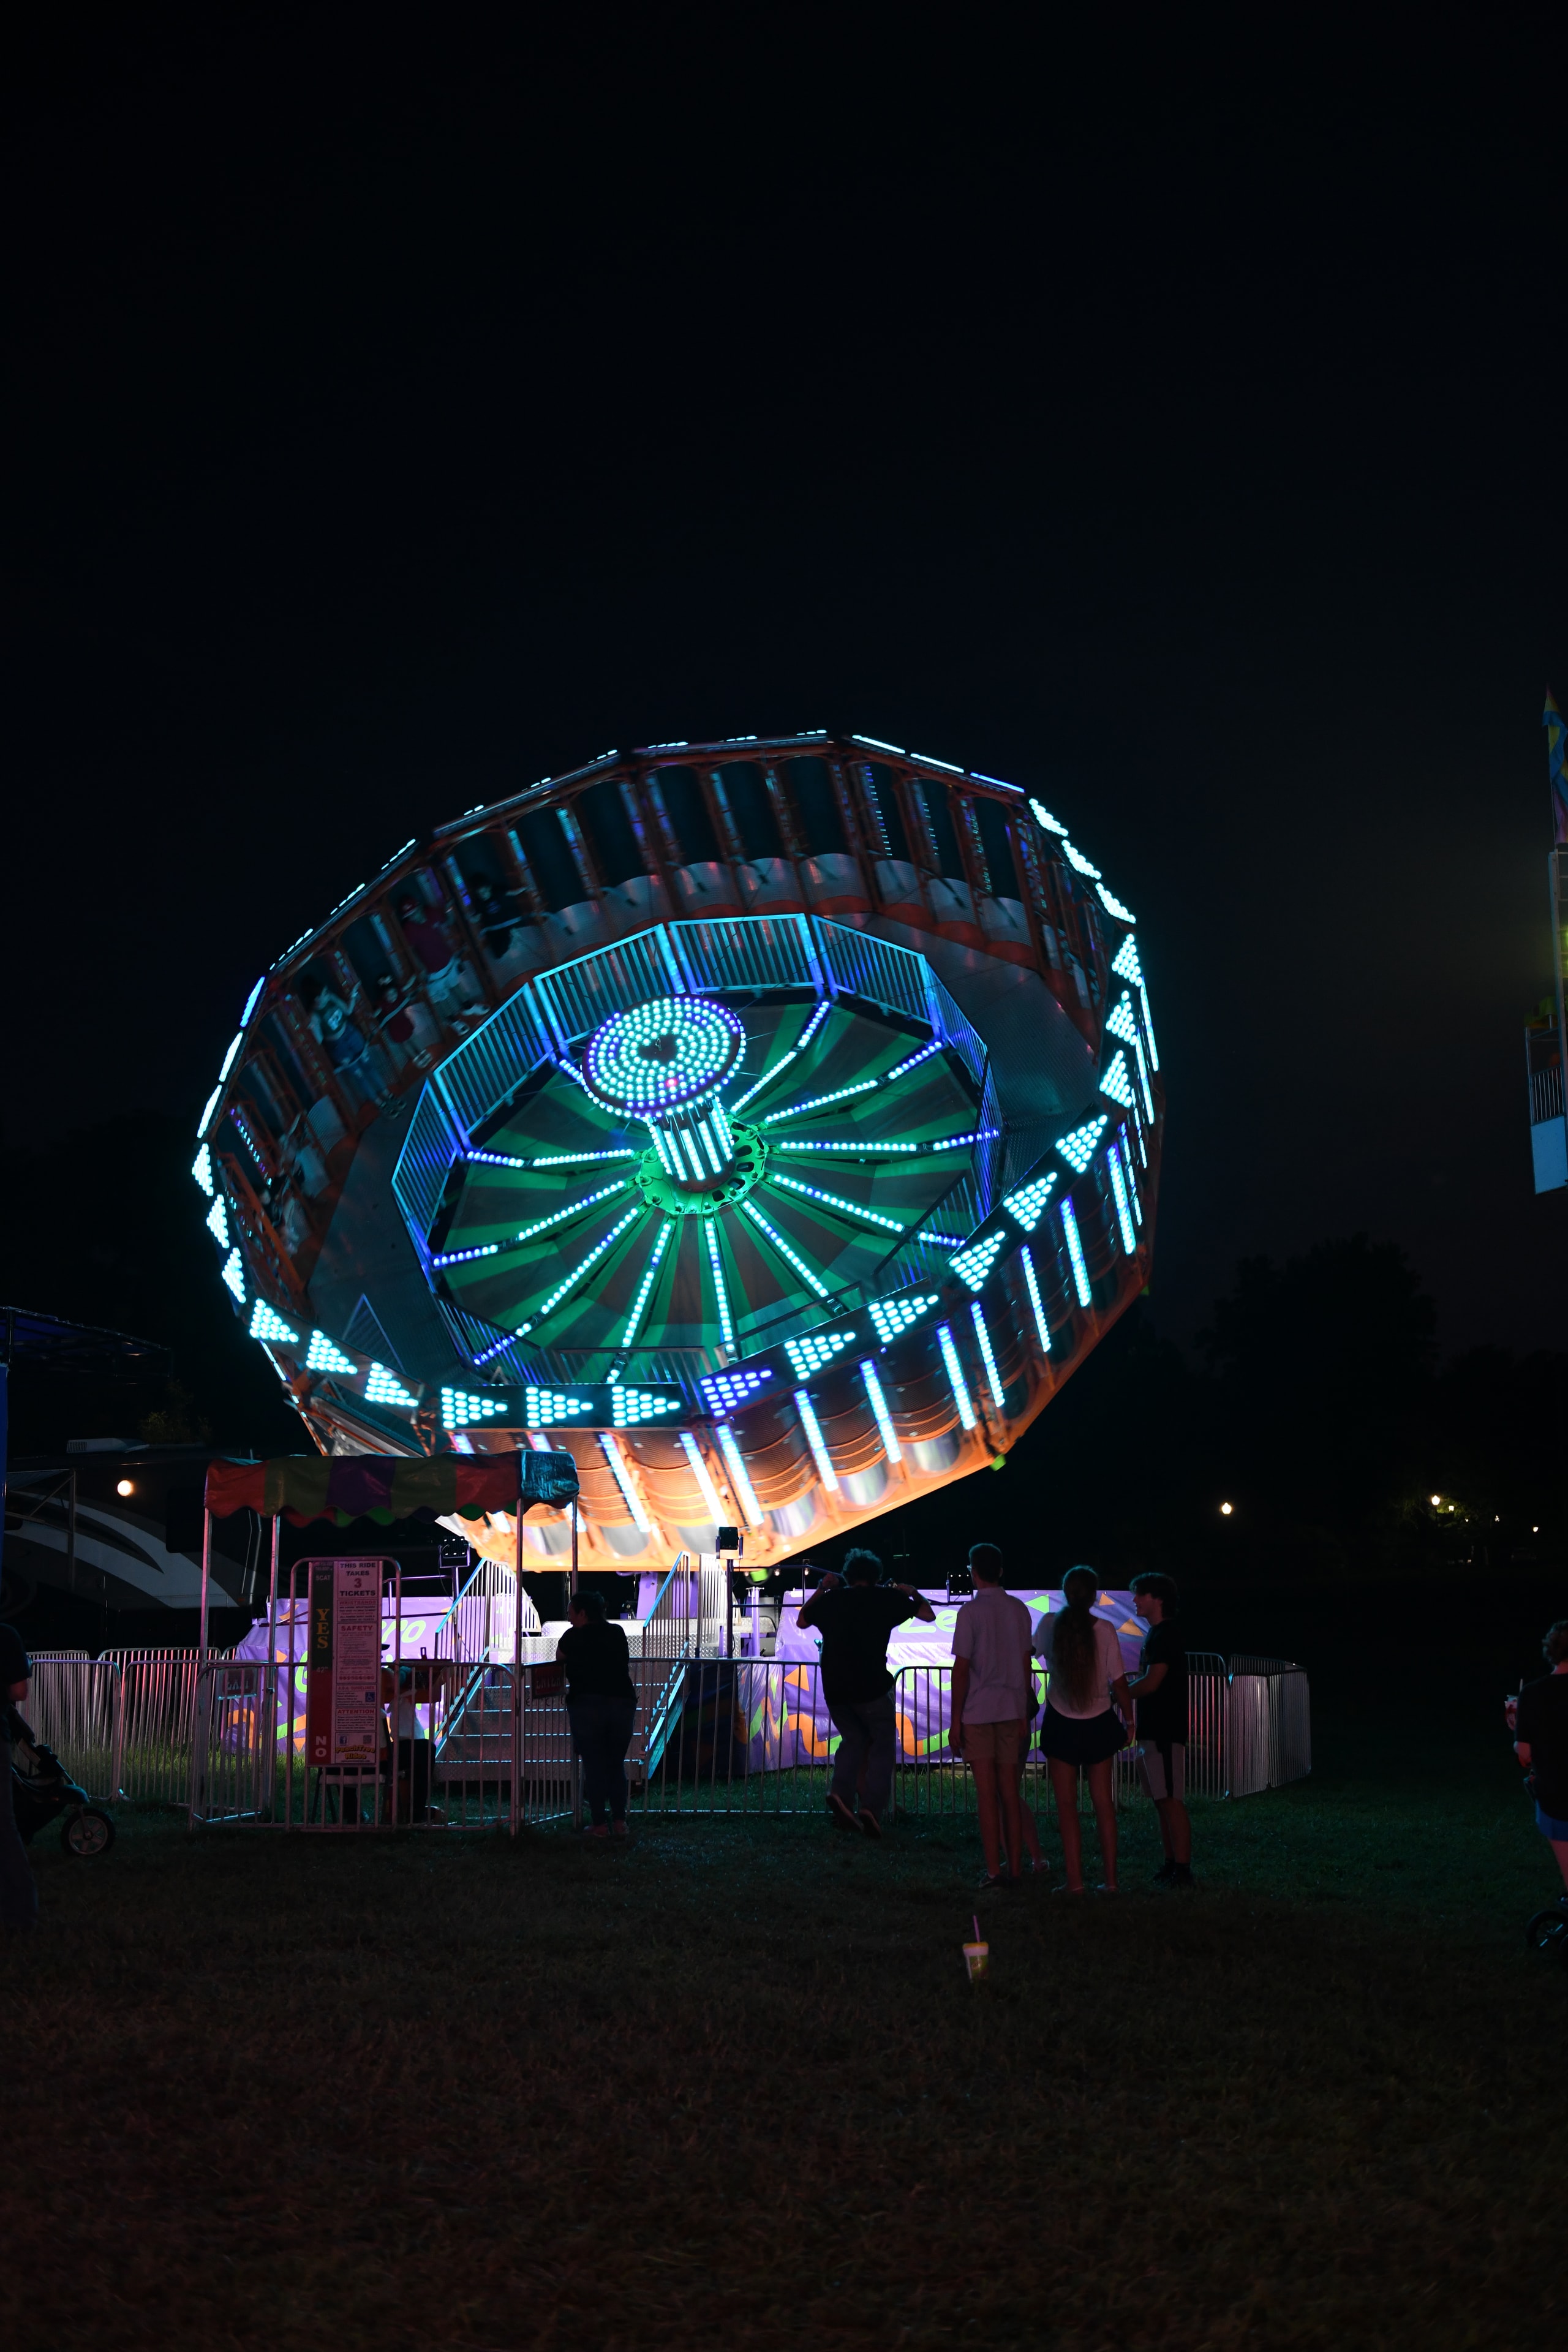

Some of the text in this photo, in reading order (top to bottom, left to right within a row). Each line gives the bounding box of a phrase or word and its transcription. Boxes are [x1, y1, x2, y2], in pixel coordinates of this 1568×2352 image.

[354, 1578, 362, 1588] 3
[316, 1608, 331, 1649] YES
[315, 1736, 327, 1758] NO
